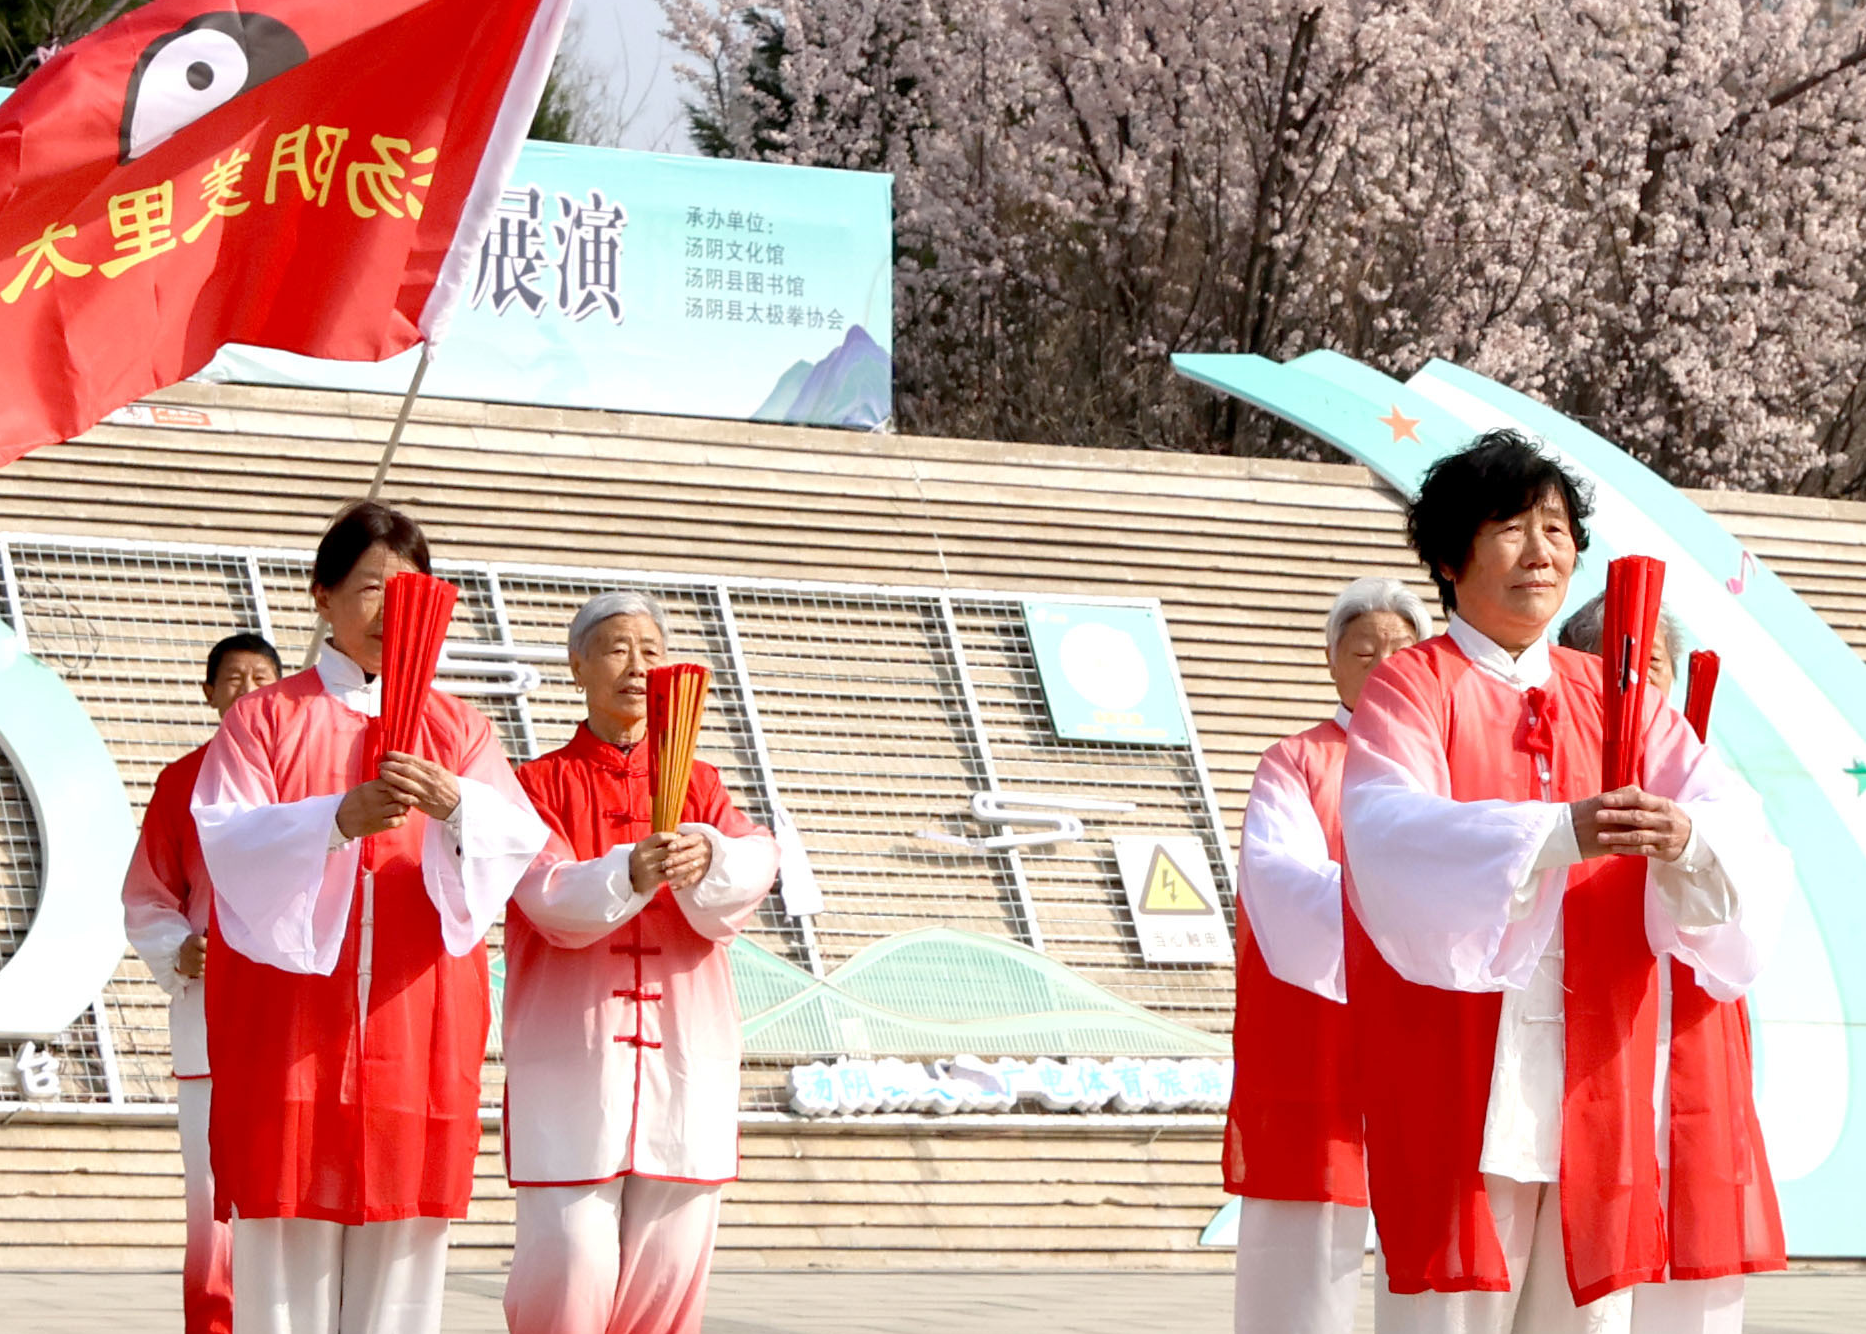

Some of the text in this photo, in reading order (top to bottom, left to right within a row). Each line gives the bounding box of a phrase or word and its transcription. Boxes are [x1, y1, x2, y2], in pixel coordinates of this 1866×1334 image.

[685, 205, 774, 235] 承办单位：
[684, 236, 786, 266] 汤阴文化馆
[684, 266, 806, 298] 汤阴县图书馆
[684, 296, 845, 332] 汤阴县太极拳协会
